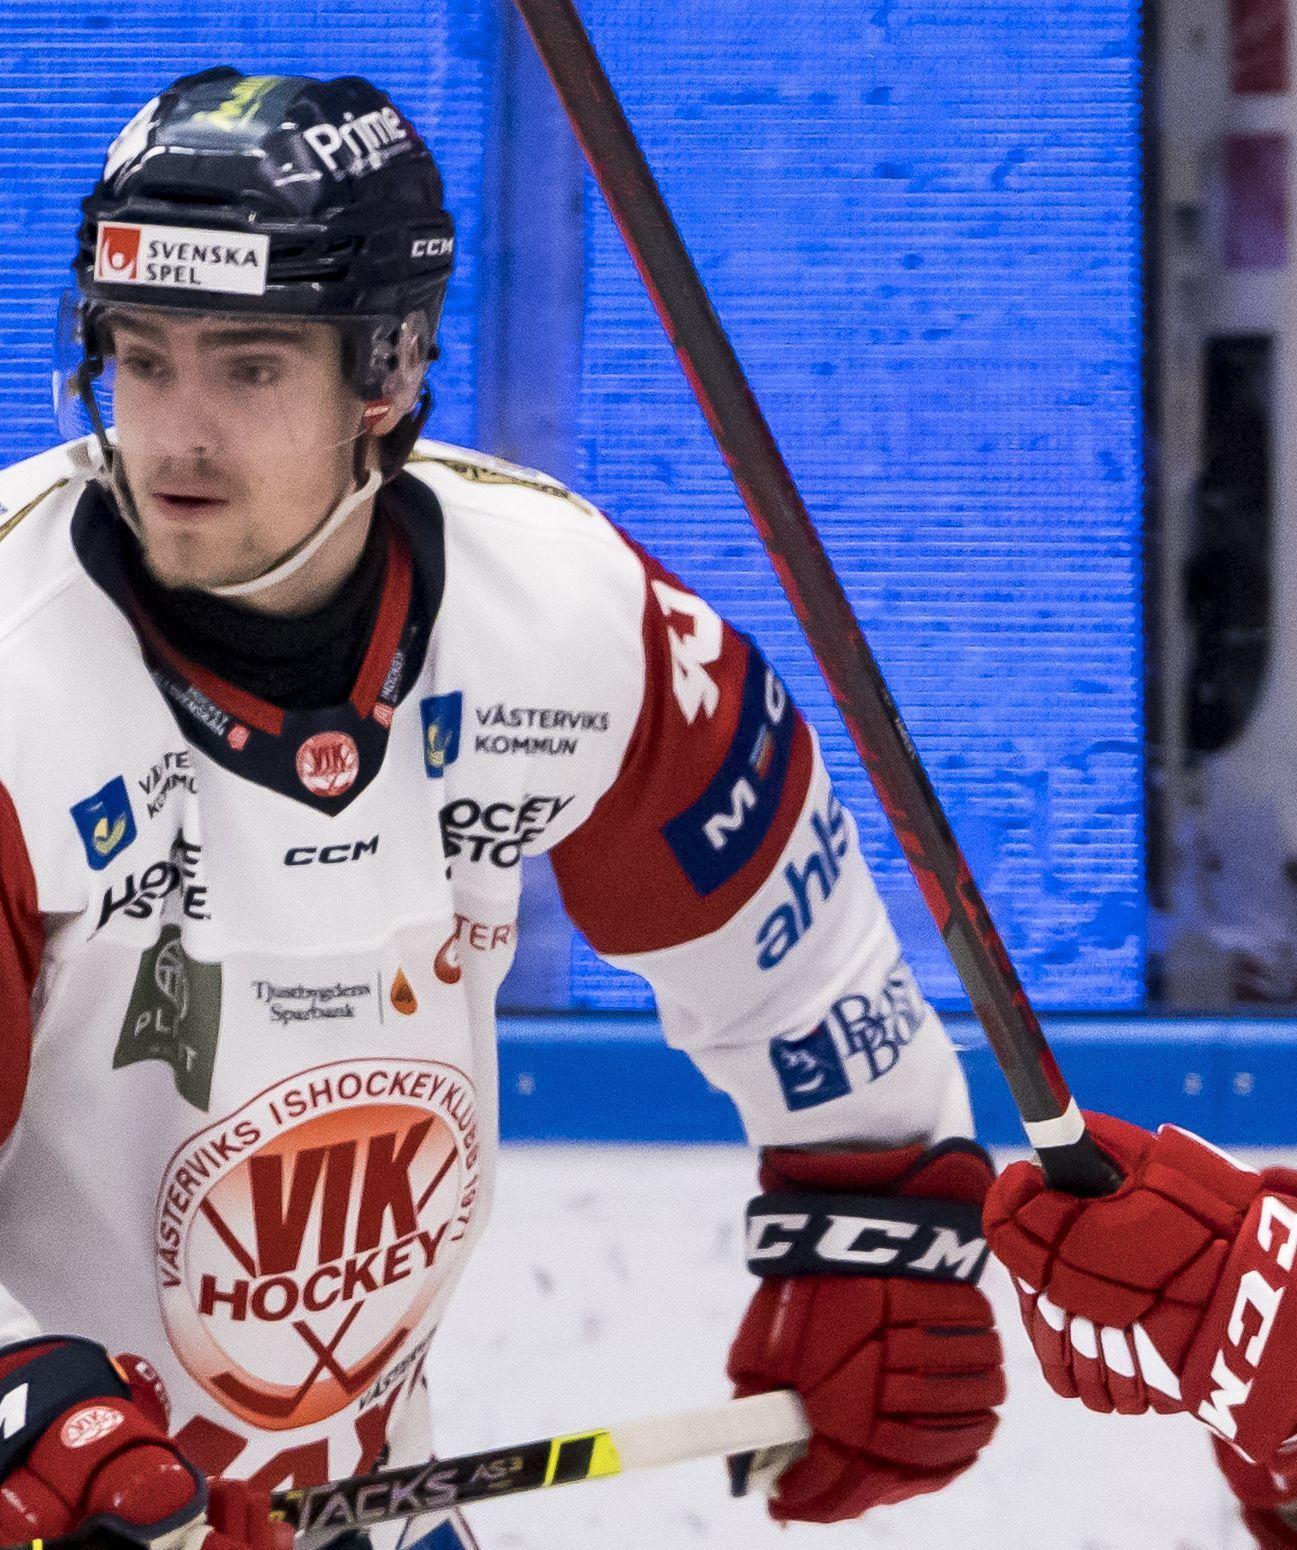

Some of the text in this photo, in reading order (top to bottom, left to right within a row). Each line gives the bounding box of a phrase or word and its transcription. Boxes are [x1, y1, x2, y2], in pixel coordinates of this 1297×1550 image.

[303, 106, 407, 173] Prime
[147, 240, 259, 268] SVENSKA
[411, 237, 454, 258] CCM
[146, 263, 202, 286] SPEL
[475, 704, 610, 732] VÄSTERVIKS
[475, 735, 579, 756] KOMMUN
[283, 835, 380, 866] CCM
[249, 1116, 433, 1276] VIK
[746, 1213, 988, 1279] CCM
[199, 1218, 451, 1322] HOCKEY
[1198, 1195, 1297, 1440] CCM
